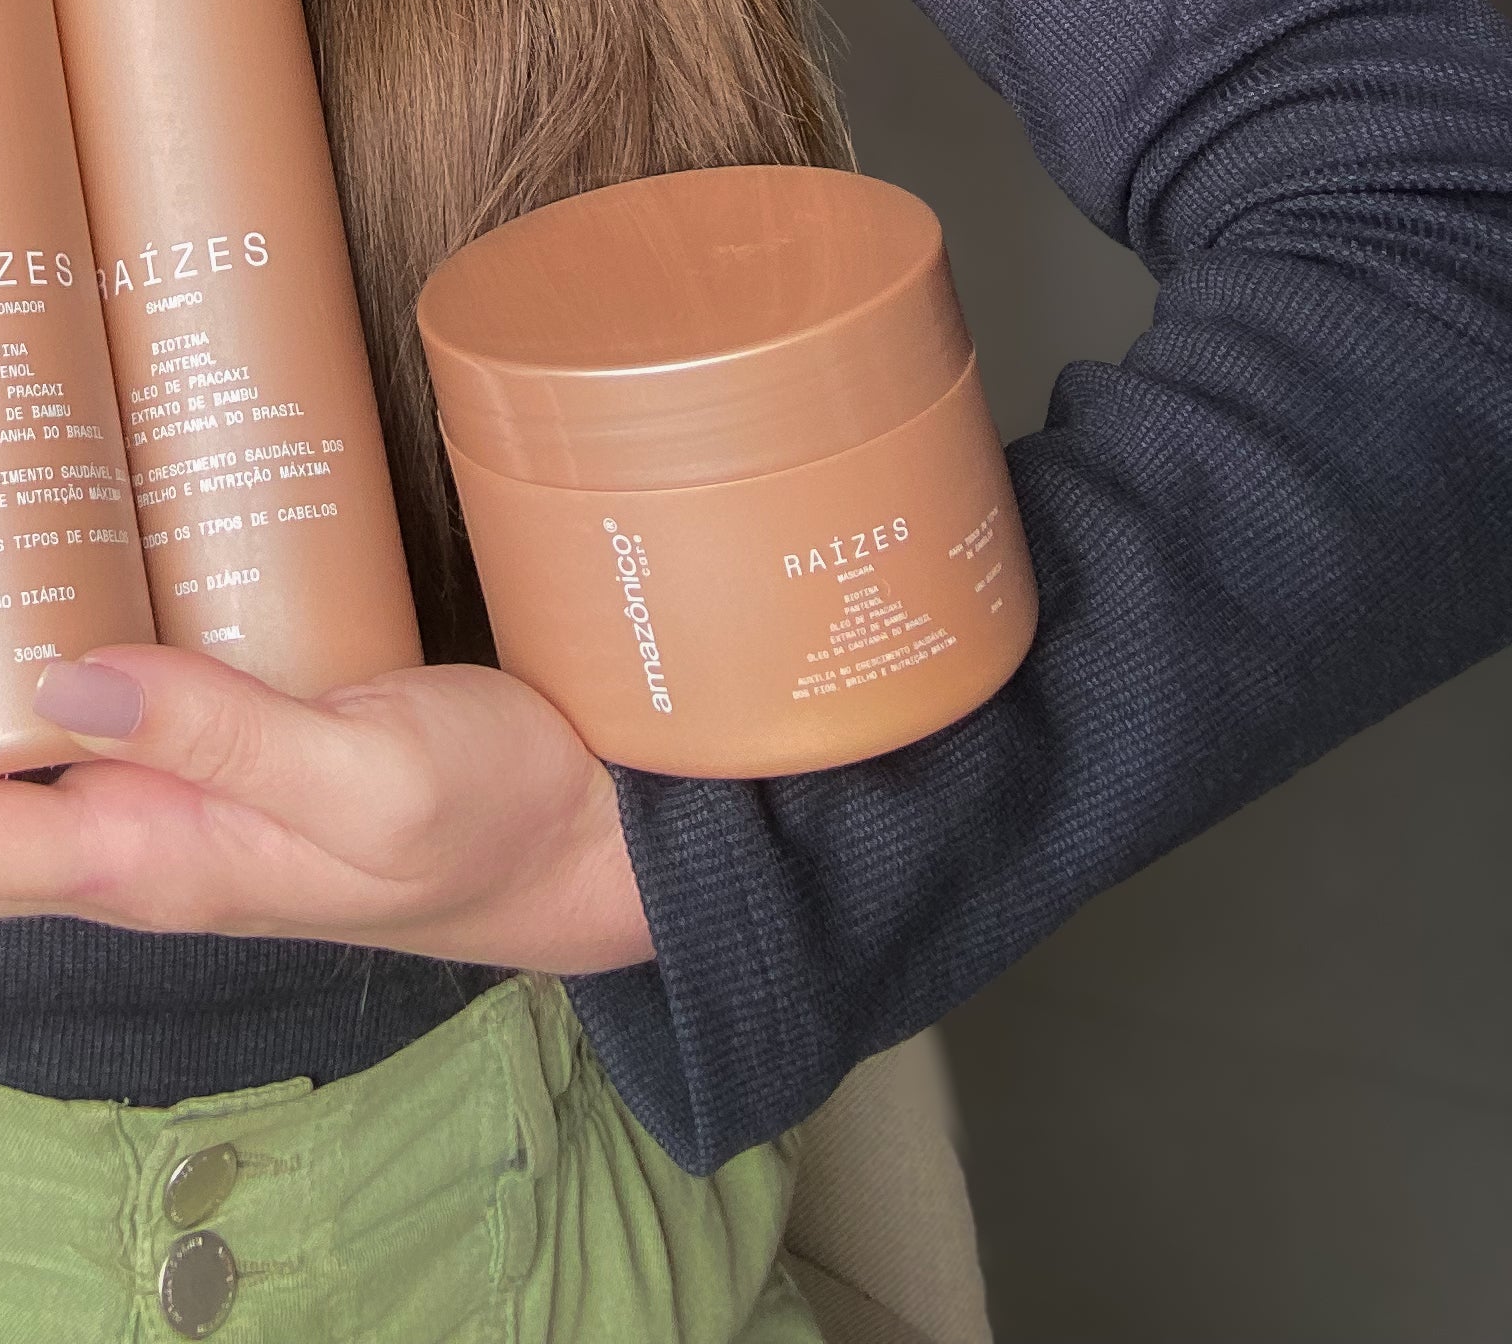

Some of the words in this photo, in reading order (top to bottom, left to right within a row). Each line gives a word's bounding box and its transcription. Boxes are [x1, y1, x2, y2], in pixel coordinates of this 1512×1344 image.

[146, 291, 203, 315] SHAMPOO
[151, 331, 210, 356] BIOTINA
[150, 352, 217, 377] PANTENOL
[7, 383, 65, 400] PRACAXI
[131, 385, 159, 404] ÓLEO
[165, 379, 182, 395] DE
[188, 366, 251, 390] PRACAXI
[6, 406, 24, 422] DE
[131, 401, 181, 426] EXTRATO
[188, 394, 206, 411] DE
[213, 386, 259, 408] BAMBU
[43, 425, 60, 440] DO
[66, 424, 105, 441] BRASIL
[152, 414, 219, 441] CASTANHA
[226, 410, 245, 427] DO
[252, 402, 305, 422] BRASIL
[148, 451, 238, 483] CRESCIMENTO
[244, 440, 316, 464] SAUDÁVEL
[322, 439, 345, 453] DOS
[184, 483, 193, 497] E
[199, 466, 272, 494] NUTRIÇÃO
[279, 461, 331, 479] MÁXIMA
[16, 483, 84, 505] NUTRIÇÃO
[143, 531, 169, 550] ODOS
[174, 525, 191, 540] OS
[198, 515, 243, 538] TIPOS
[250, 510, 269, 527] DE
[277, 502, 338, 523] CABELOS
[13, 531, 60, 550] TIPOS
[66, 529, 84, 545] DE
[783, 517, 910, 579] RAÍZES
[632, 534, 651, 577] care
[174, 579, 199, 597] USO
[206, 567, 261, 592] DIÁRIO
[21, 584, 76, 607] DIÁRIO
[201, 624, 246, 646] 300ML
[13, 643, 63, 664] 300ML
